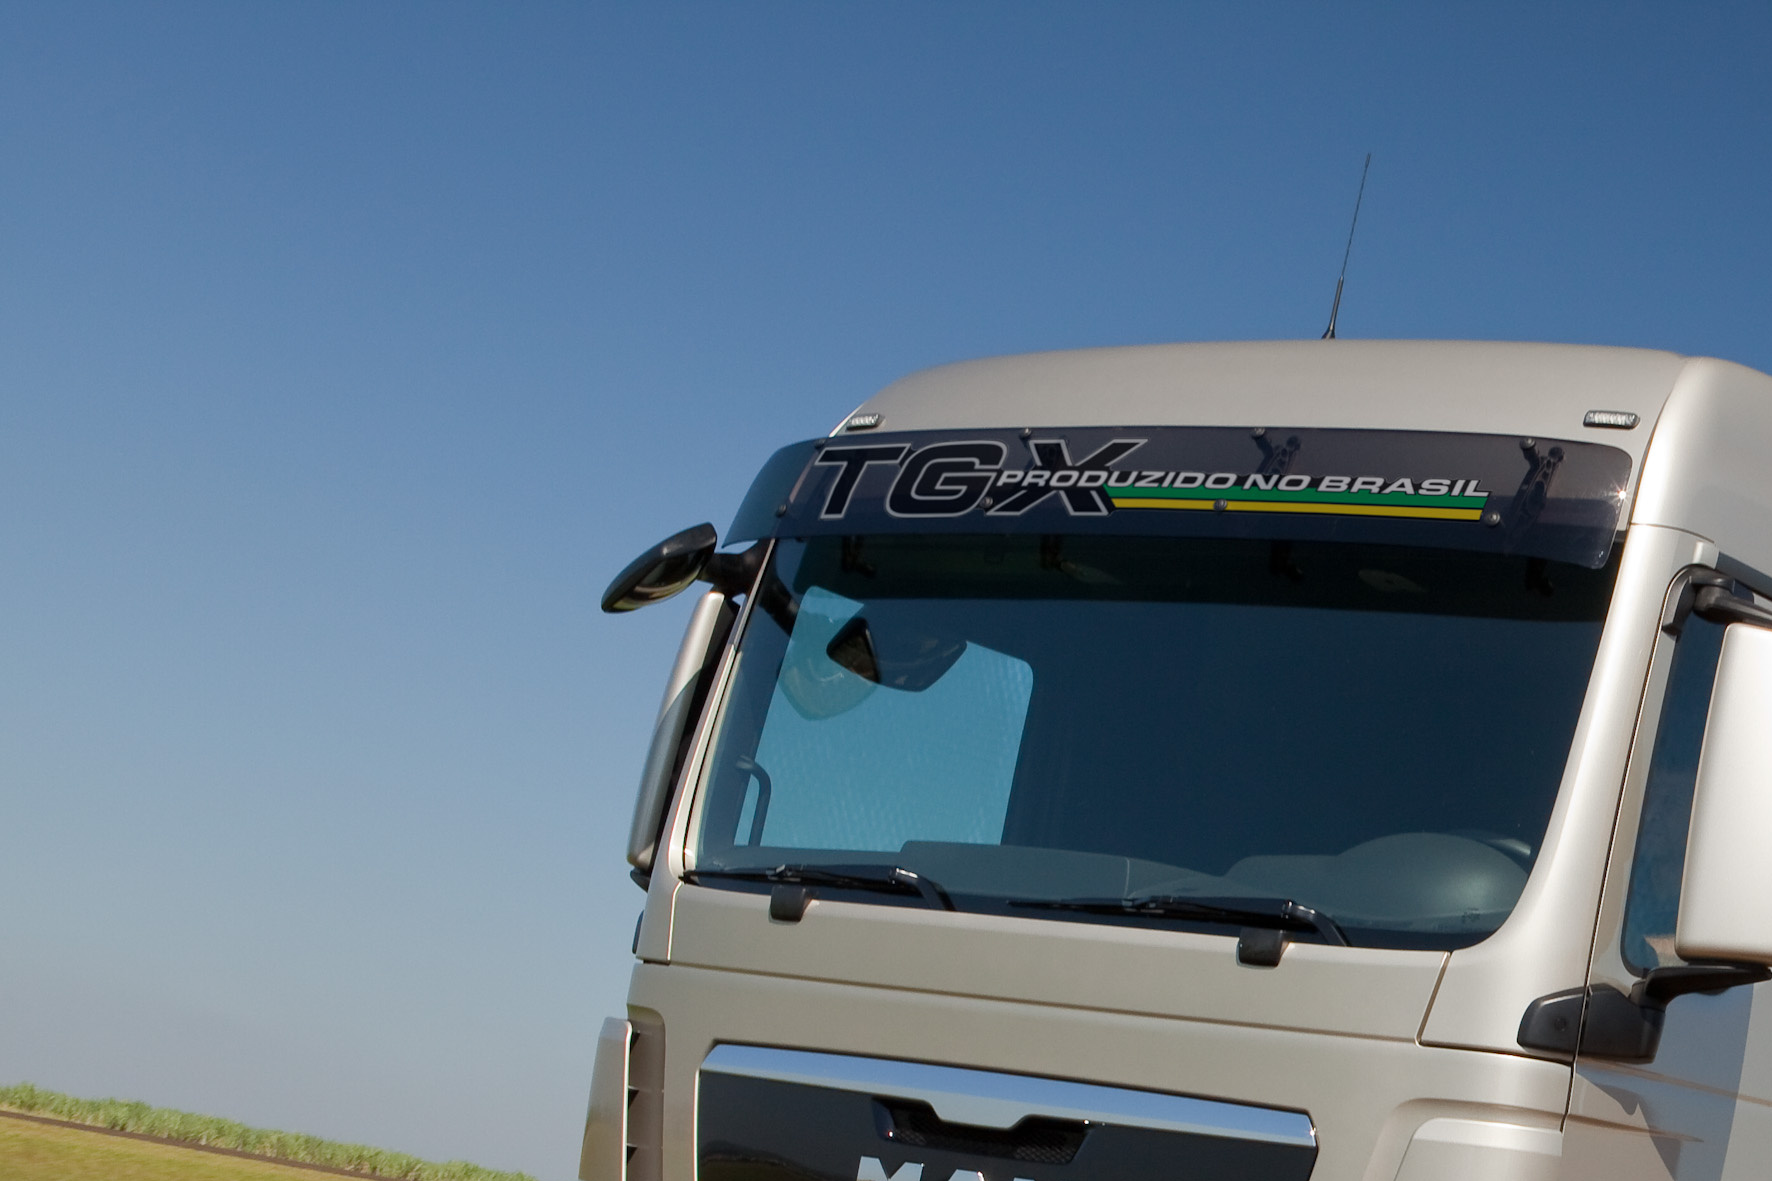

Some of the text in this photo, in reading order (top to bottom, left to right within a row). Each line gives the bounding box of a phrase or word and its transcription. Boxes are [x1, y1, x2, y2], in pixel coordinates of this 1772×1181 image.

[814, 438, 1148, 520] TGX
[996, 469, 1490, 498] PRODUZIDO NO BRASIL
